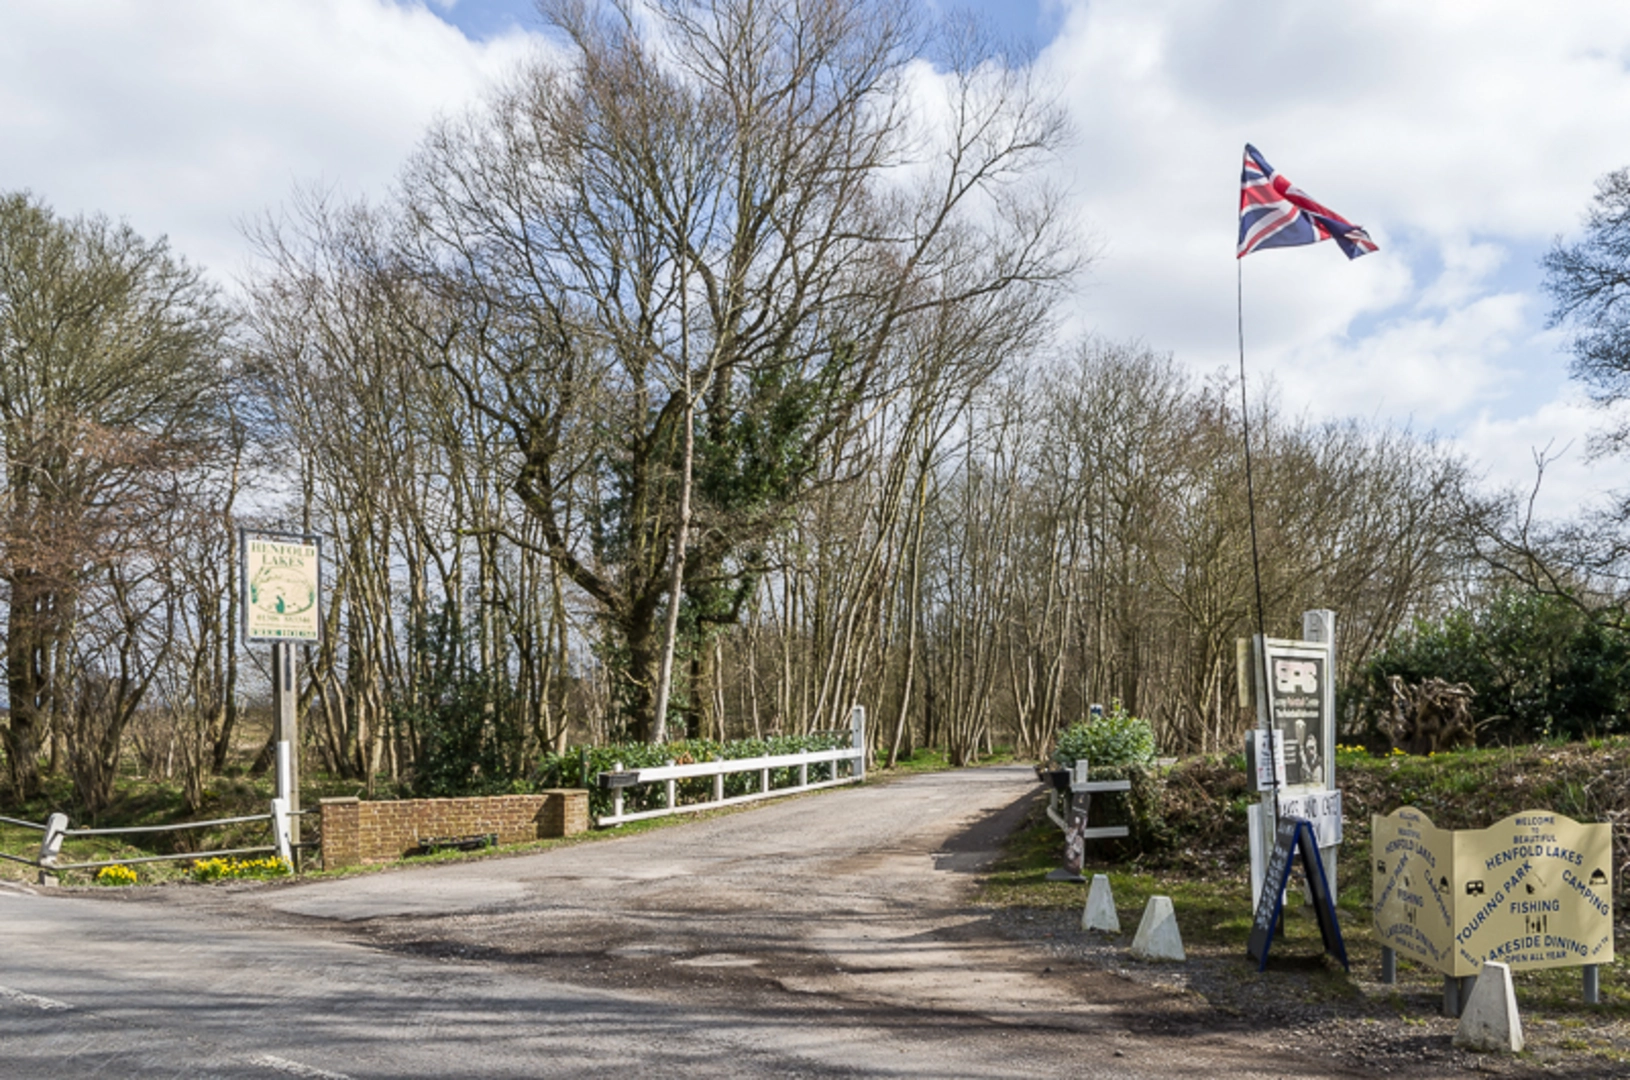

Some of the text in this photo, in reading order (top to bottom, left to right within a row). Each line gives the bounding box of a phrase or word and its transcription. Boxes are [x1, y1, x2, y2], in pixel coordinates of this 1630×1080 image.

[251, 541, 315, 557] HENFOLD
[262, 554, 305, 567] LAKES
[1515, 817, 1556, 826] WELCOME
[1513, 835, 1557, 844] BEAUTIFUL
[1385, 839, 1436, 868] HENFOLD LAKES
[1485, 845, 1584, 870] HENFOLD LAKES
[1397, 888, 1424, 908] FISHING
[1424, 869, 1451, 927] CAMPING
[1456, 860, 1533, 945] TOURING PARK
[1562, 869, 1610, 916] CAMPING
[1510, 899, 1560, 913] FISHING
[1415, 928, 1439, 962] DINING
[1481, 935, 1541, 963] LAKESIDE
[1544, 935, 1588, 957] DINING
[1505, 950, 1567, 963] OPEN ALL YEAR
